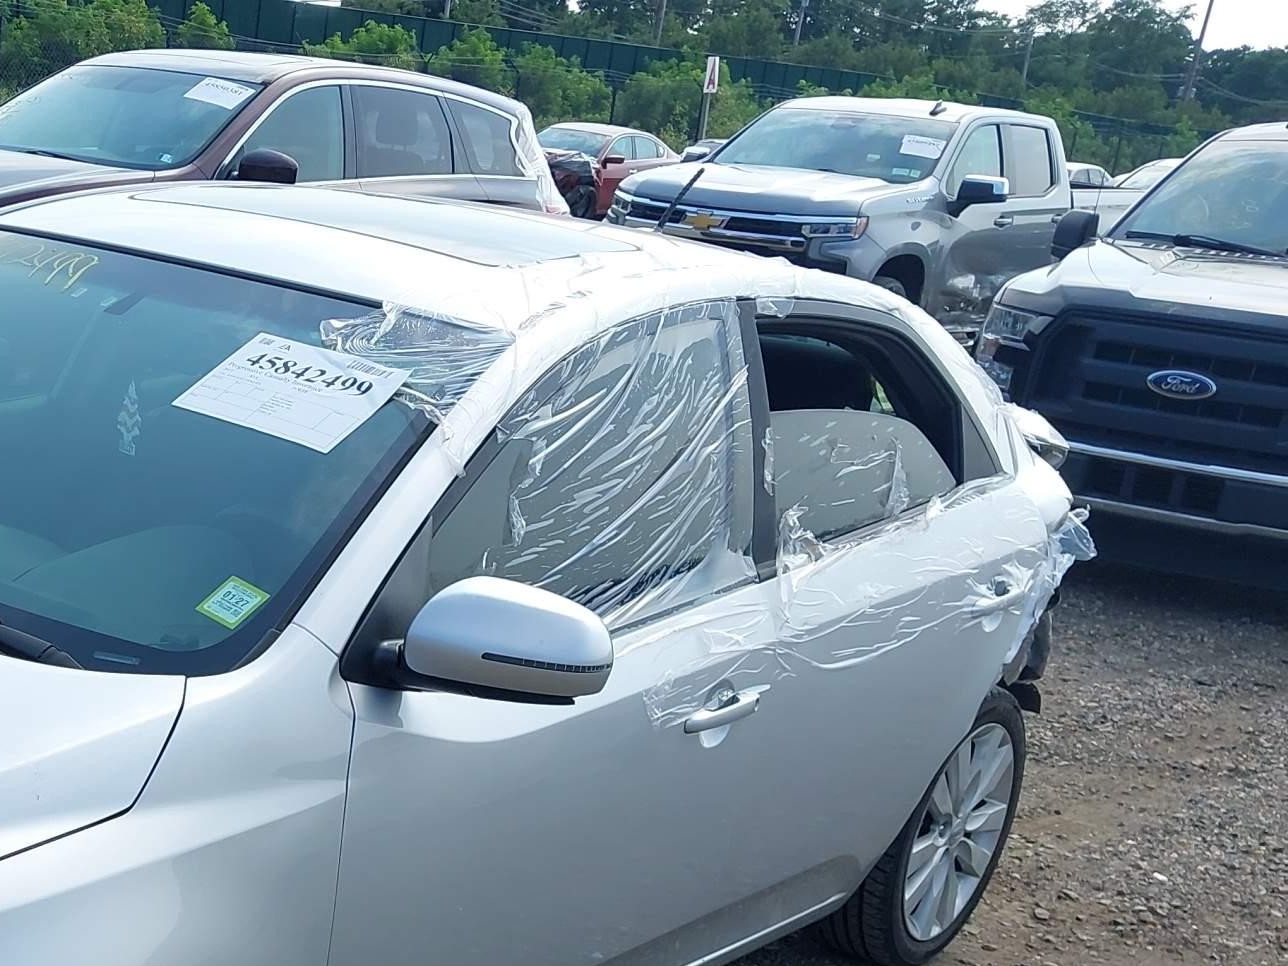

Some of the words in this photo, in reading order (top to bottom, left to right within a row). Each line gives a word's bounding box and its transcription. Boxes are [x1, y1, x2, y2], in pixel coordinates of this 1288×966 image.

[706, 57, 716, 90] A
[245, 352, 376, 397] 45842499
[1161, 375, 1201, 394] Ford
